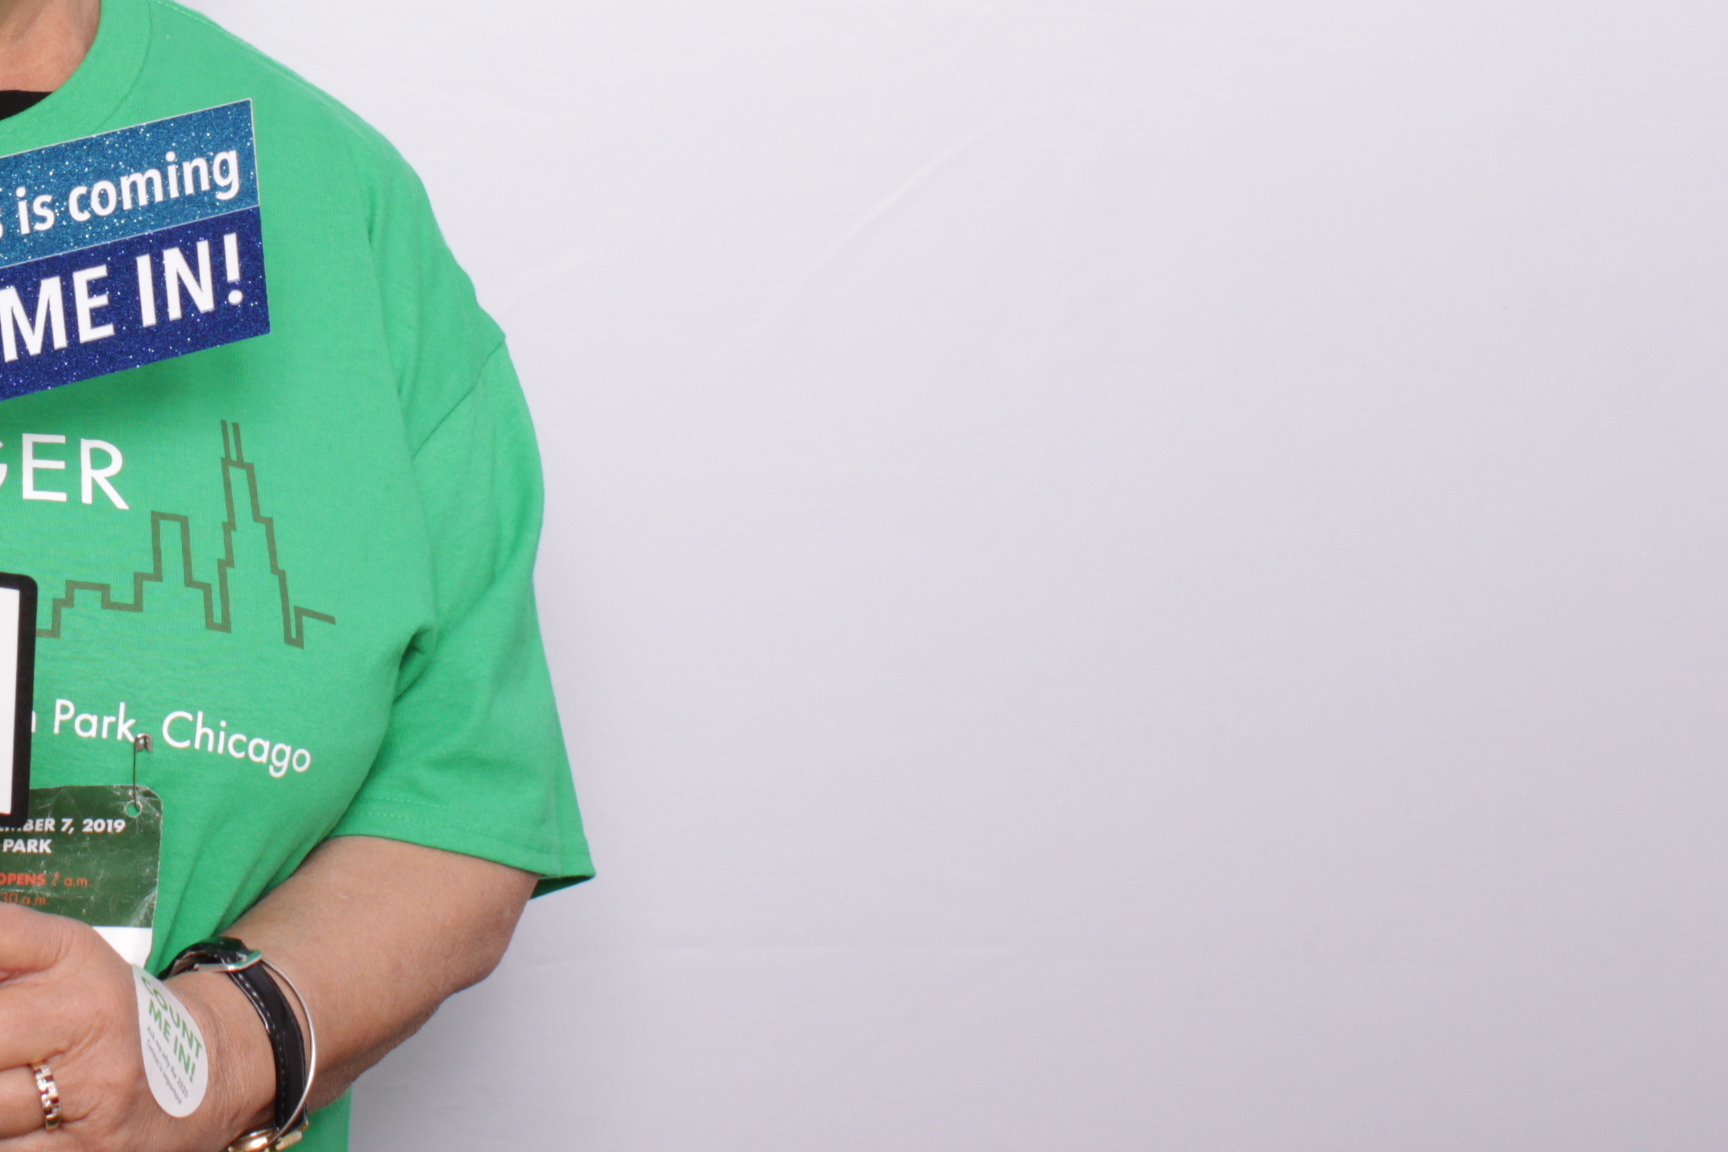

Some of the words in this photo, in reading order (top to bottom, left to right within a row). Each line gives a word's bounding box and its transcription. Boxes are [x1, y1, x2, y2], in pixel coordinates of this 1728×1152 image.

[15, 186, 56, 235] is
[67, 149, 240, 221] coming
[137, 233, 244, 328] IN!
[53, 698, 136, 743] Park
[162, 711, 311, 778] Chicago
[3, 838, 52, 854] PARK
[60, 818, 74, 834] 7,
[82, 819, 126, 834] 2019
[141, 976, 202, 1060] COUNT
[148, 998, 171, 1043] ME
[174, 1035, 196, 1083] IN!
